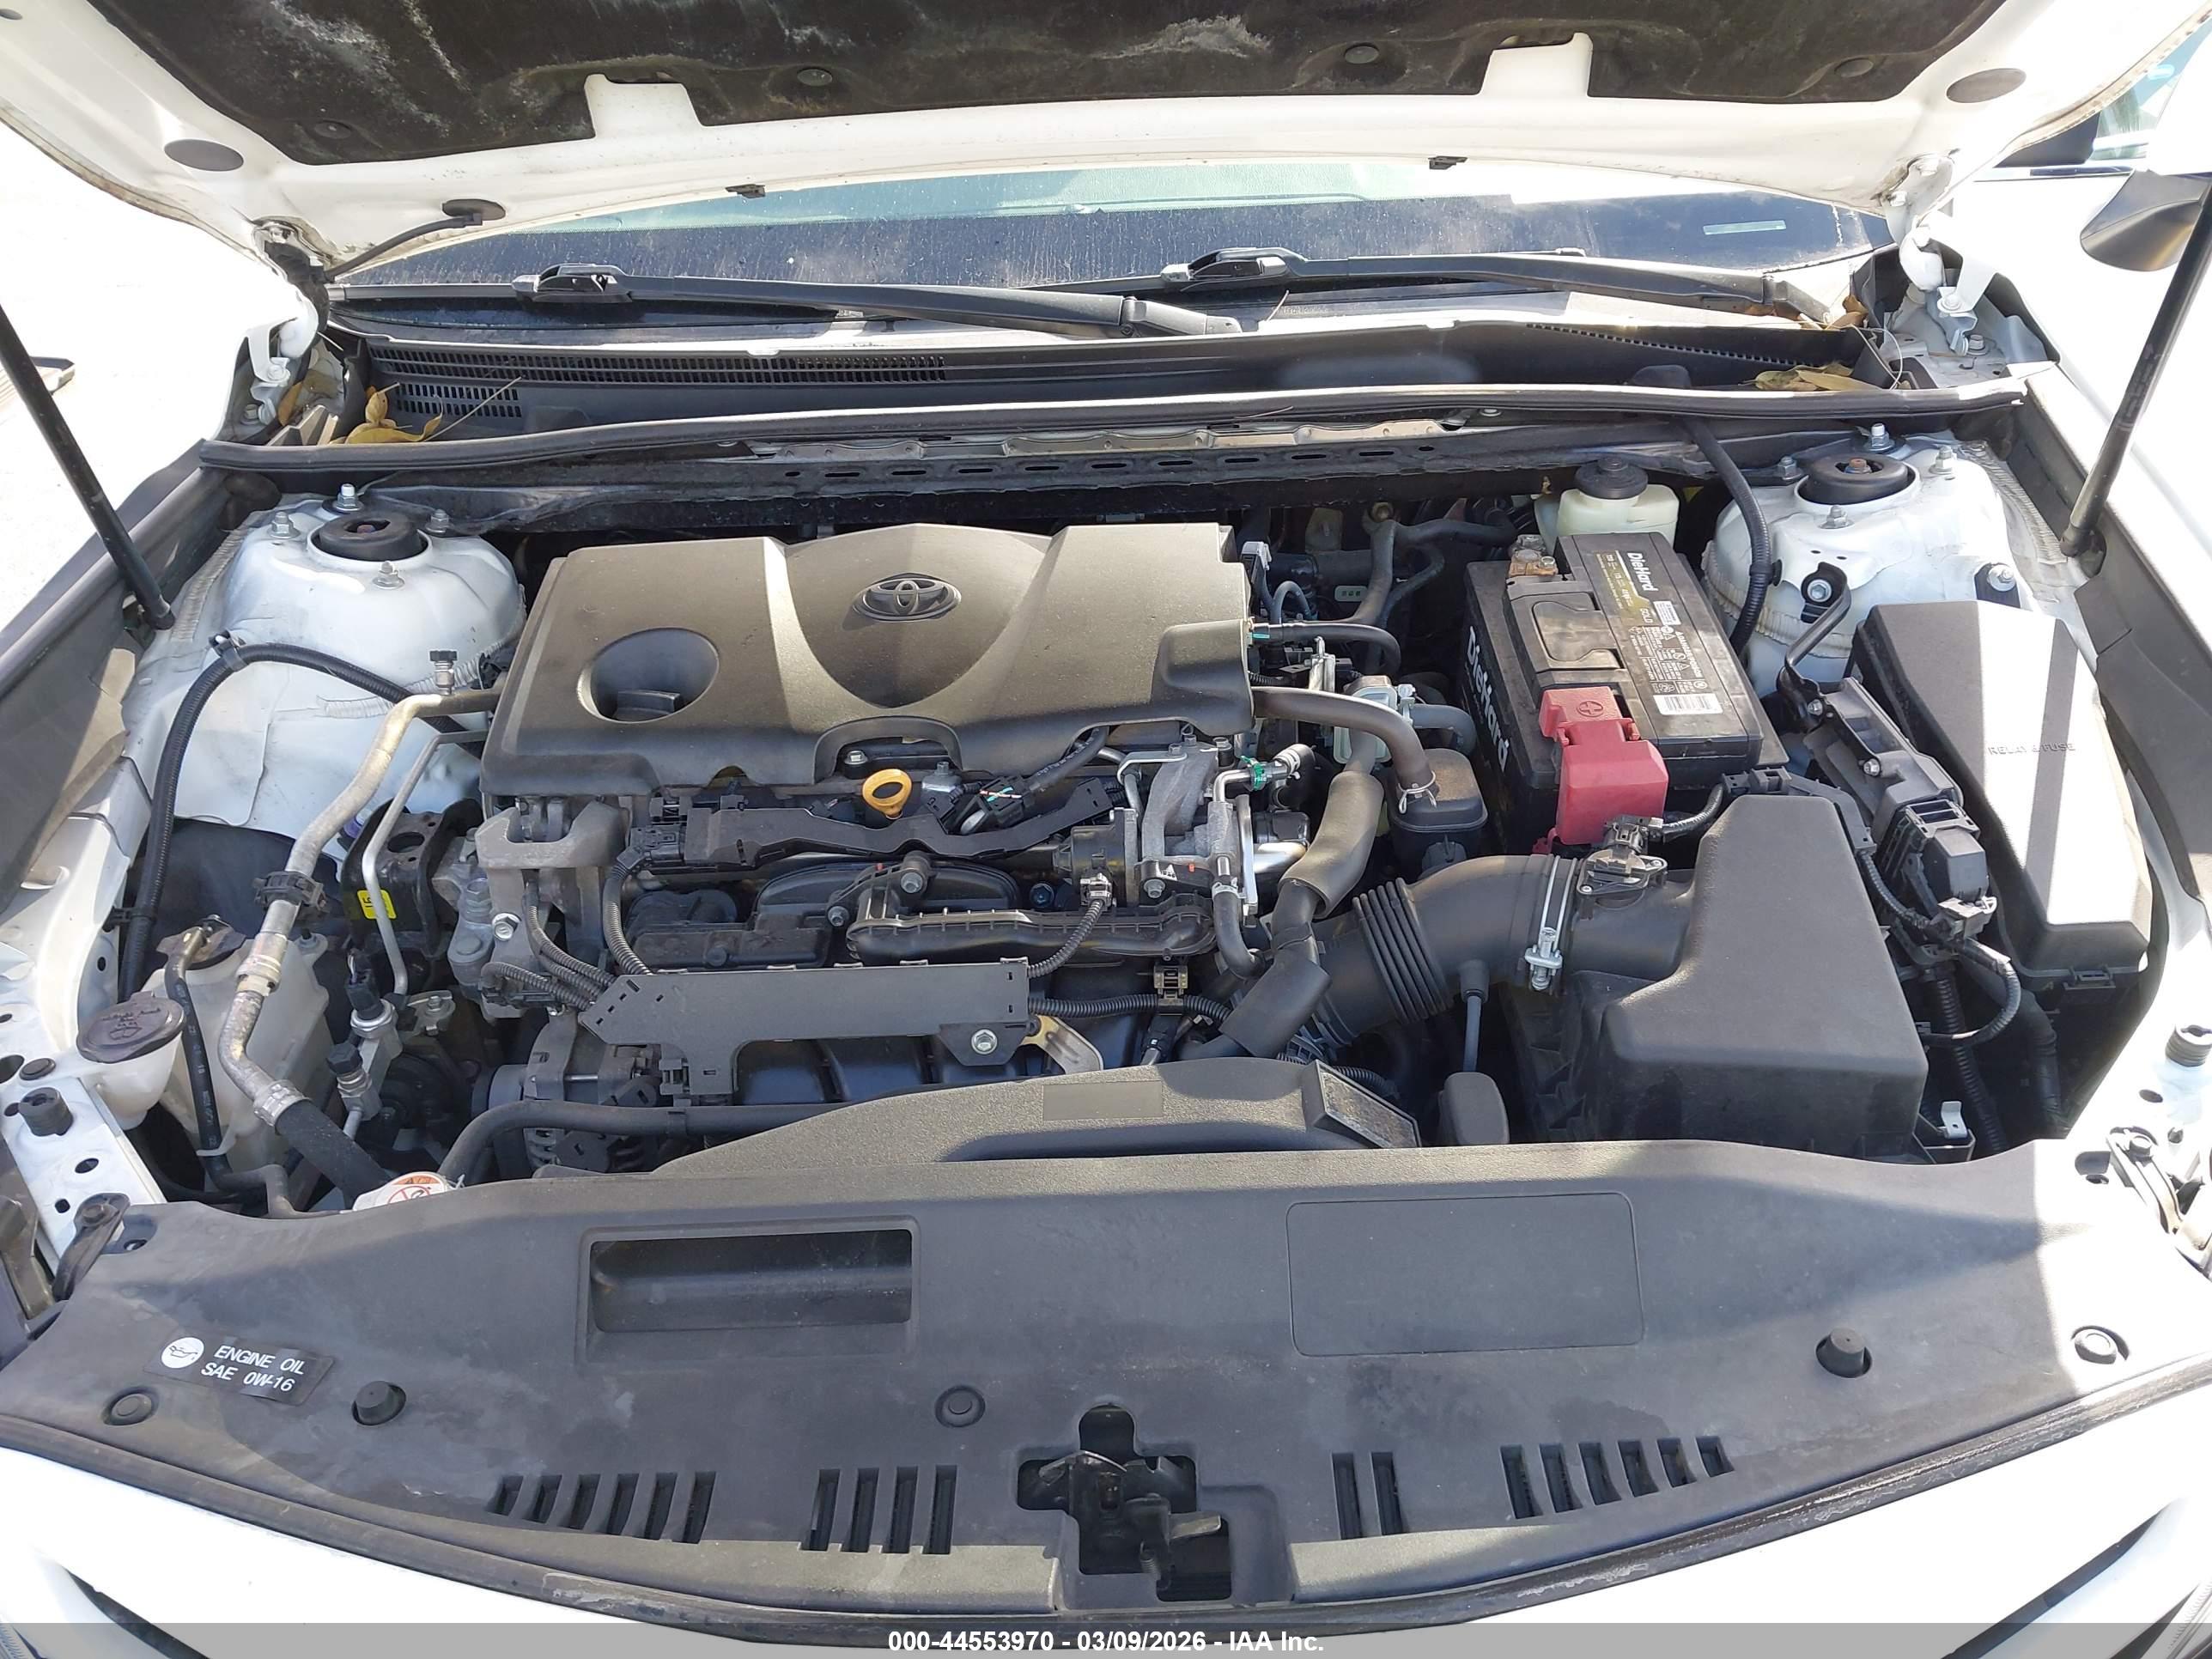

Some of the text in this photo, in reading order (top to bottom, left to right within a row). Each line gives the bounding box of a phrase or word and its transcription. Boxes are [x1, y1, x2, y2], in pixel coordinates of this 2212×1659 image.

[1626, 552, 1659, 592] DieHard
[1639, 607, 1654, 623] GOLD
[1467, 625, 1510, 772] DieHard
[2040, 742, 2076, 753] FUSE
[214, 1345, 307, 1375] ENGINE OIL
[200, 1363, 295, 1393] SAE 0W-16
